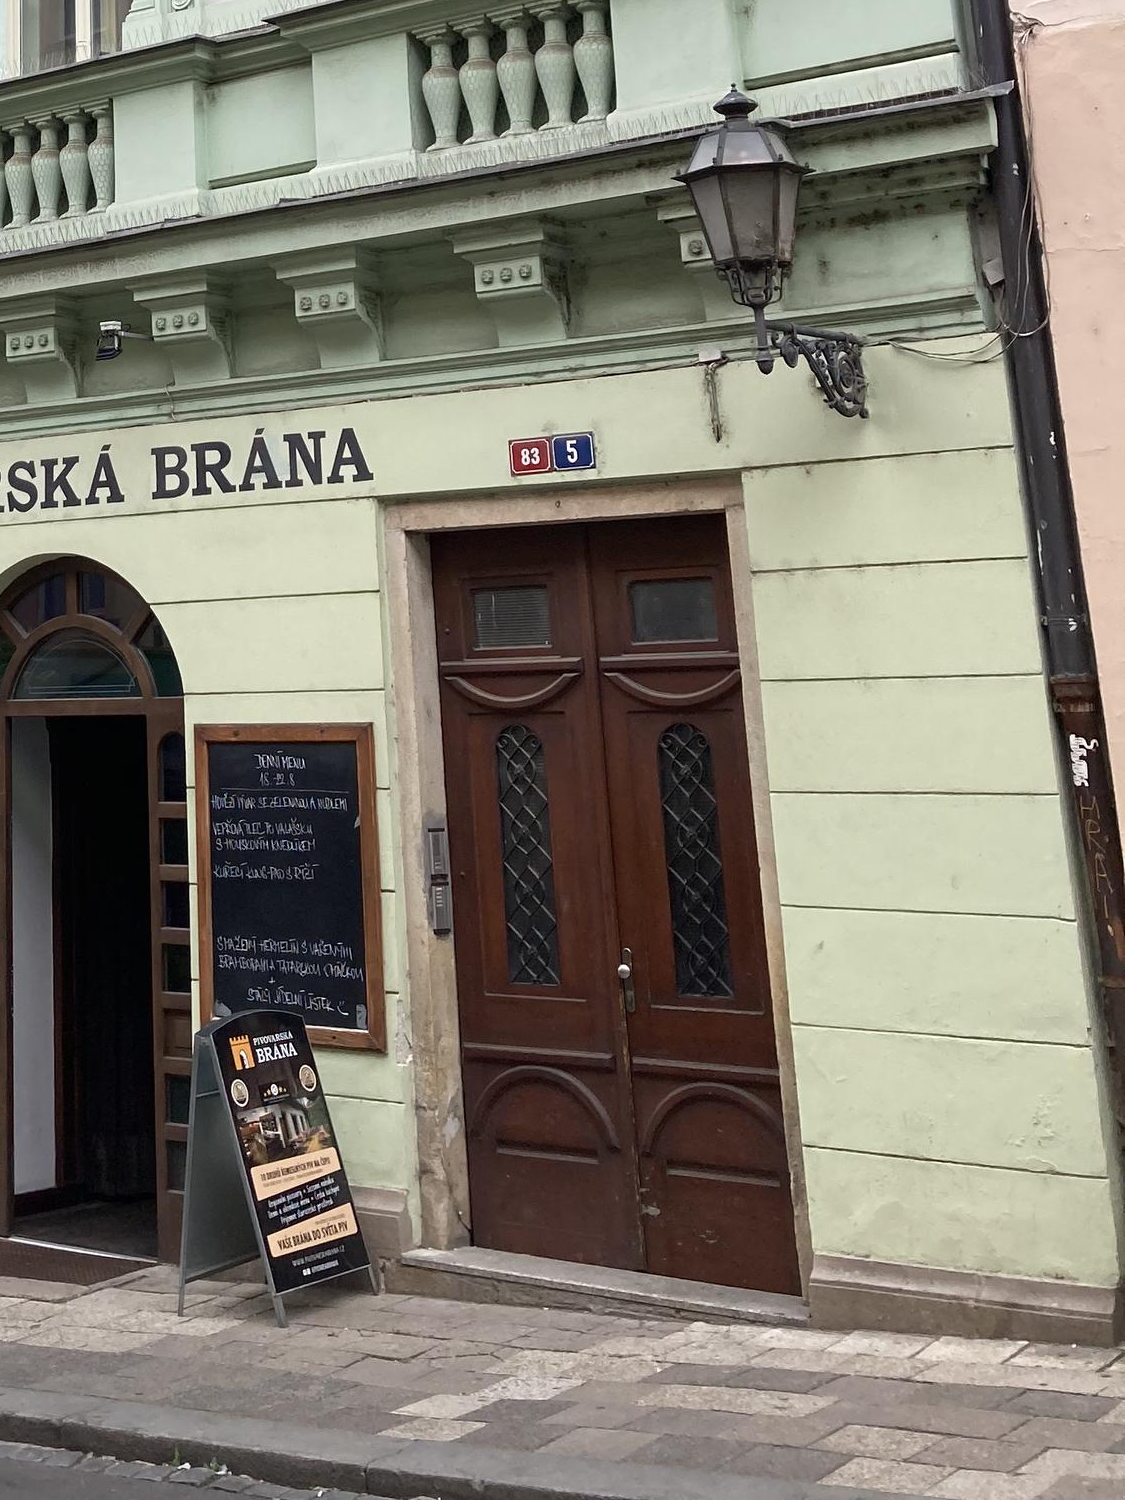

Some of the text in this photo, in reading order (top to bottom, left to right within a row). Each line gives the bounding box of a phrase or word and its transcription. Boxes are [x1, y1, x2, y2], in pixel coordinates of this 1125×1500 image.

[520, 447, 541, 466] 83
[565, 439, 579, 464] 5
[151, 428, 375, 501] BRÁNA
[254, 749, 306, 769] DENNÍ MENU
[217, 935, 257, 953] SMAŽENÝ
[259, 938, 299, 954] HERMELÍN
[301, 940, 307, 954] S
[277, 1220, 348, 1250] VAŠE BRÁNA DO SVĚTA PIV
